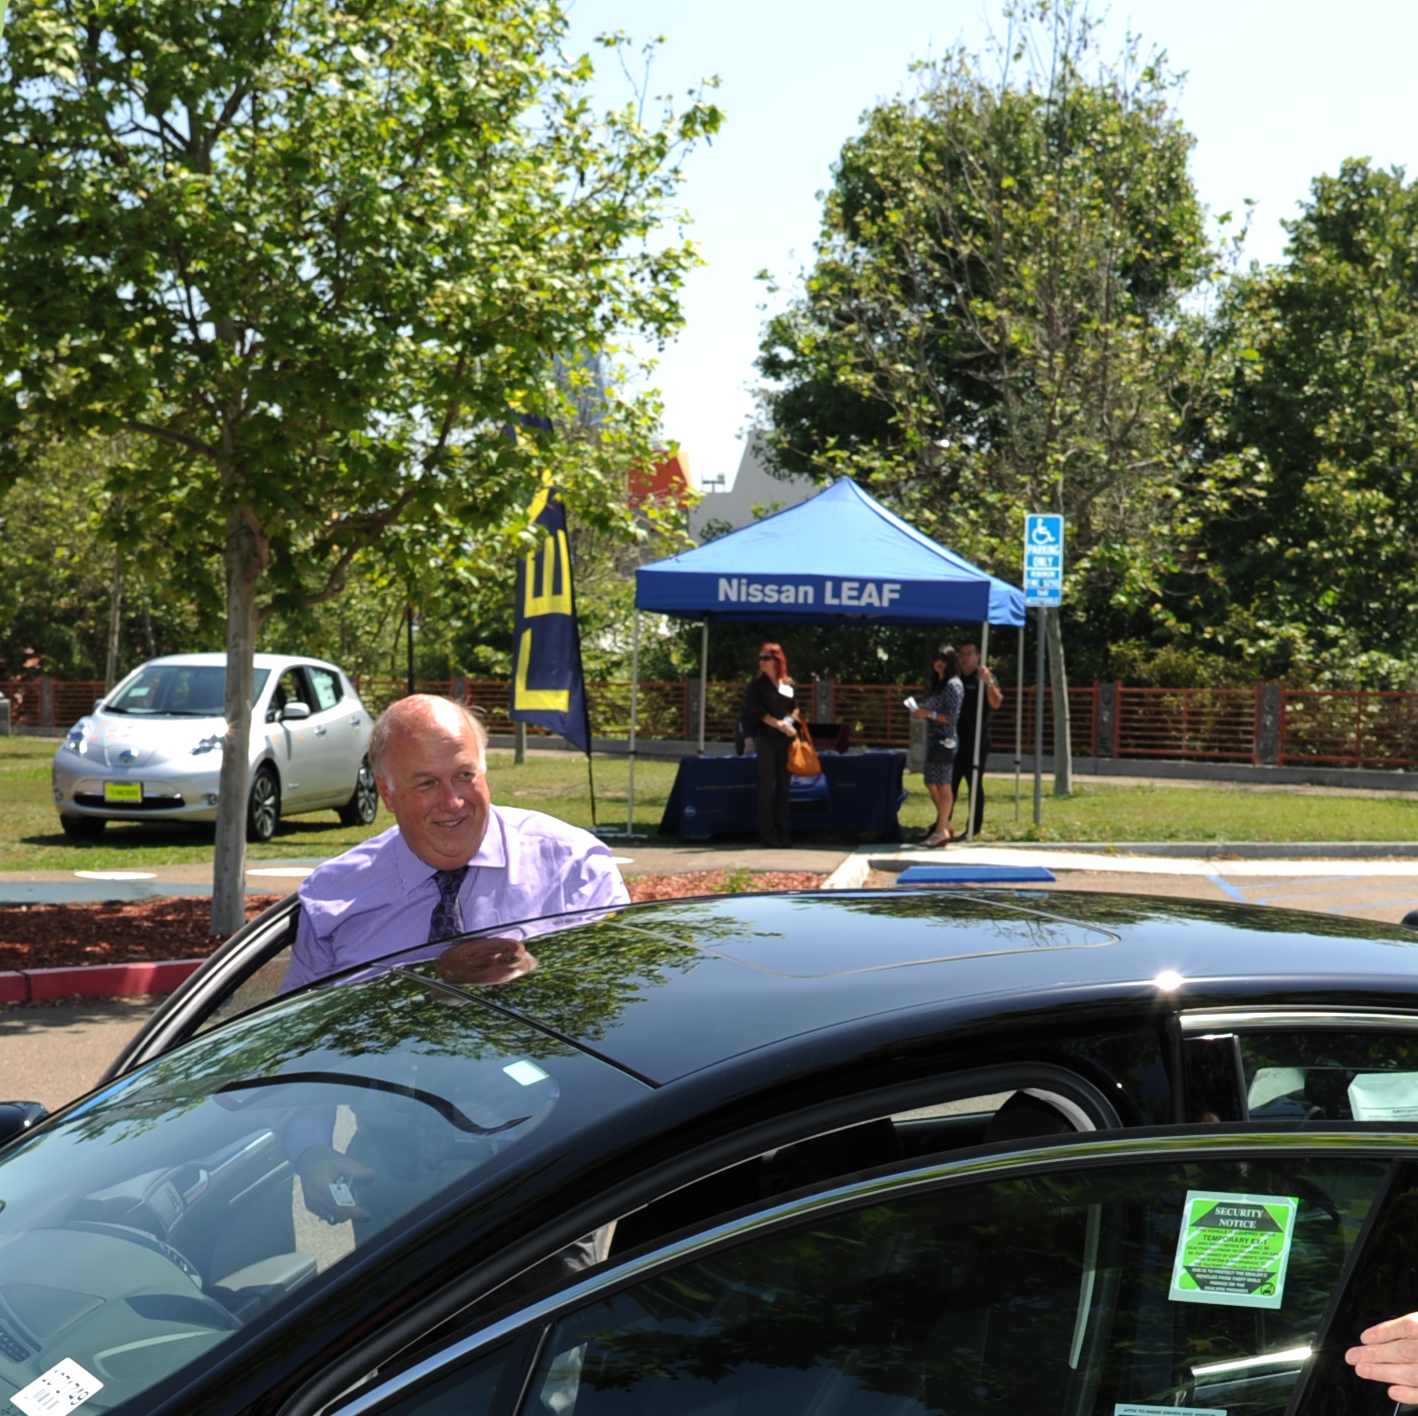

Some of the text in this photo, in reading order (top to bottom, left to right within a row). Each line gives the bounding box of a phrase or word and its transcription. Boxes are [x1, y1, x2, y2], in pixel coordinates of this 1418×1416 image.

[1028, 545, 1060, 556] PARKING
[1033, 556, 1054, 567] ONLY
[718, 578, 902, 608] Nissan LEAF
[1215, 1206, 1265, 1219] SECURITY
[1219, 1218, 1257, 1230] NOTICE
[1203, 1234, 1249, 1244] TEMPORARY
